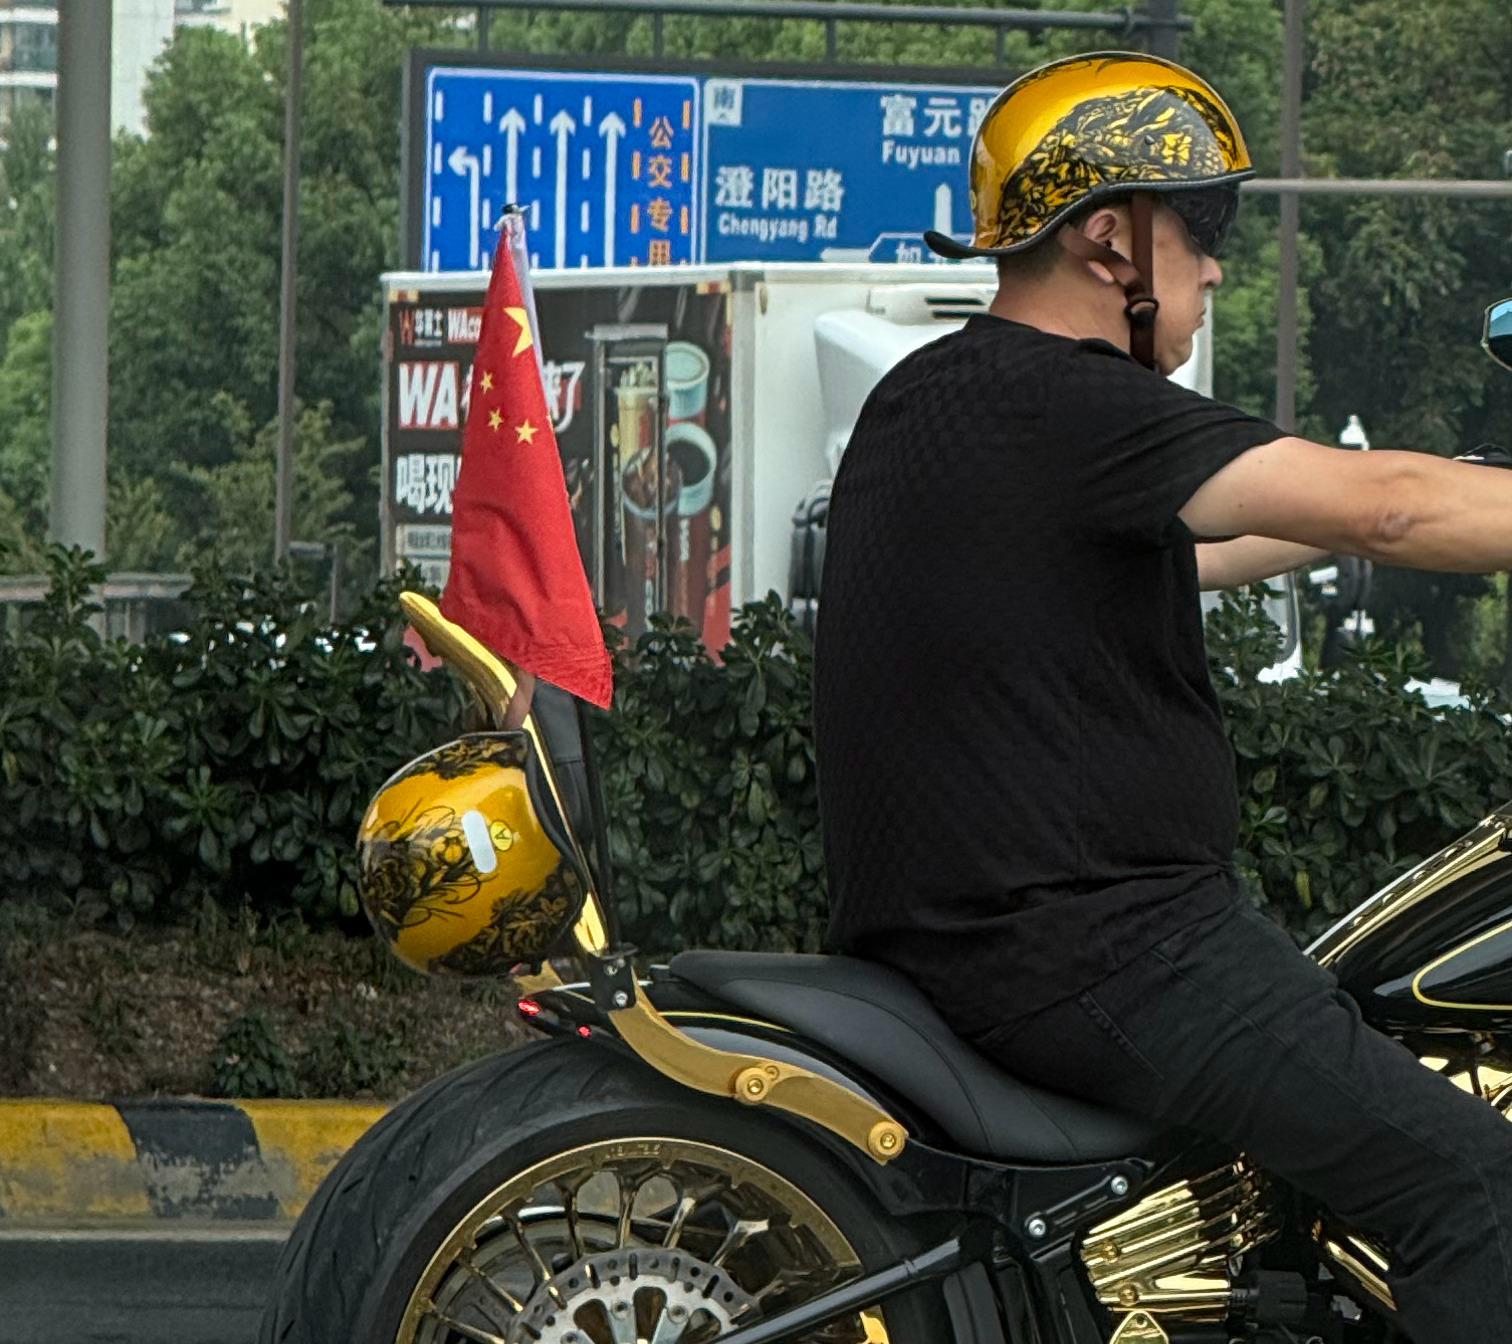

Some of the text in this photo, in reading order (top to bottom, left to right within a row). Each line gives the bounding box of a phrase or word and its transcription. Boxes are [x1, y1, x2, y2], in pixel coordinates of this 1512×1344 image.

[882, 139, 960, 170] Fuyuan
[647, 116, 674, 266] 公交专用
[715, 165, 845, 212] 澄阳路
[718, 212, 838, 243] Chengyang Rd
[399, 362, 459, 427] WA
[396, 453, 462, 514] 喝现
